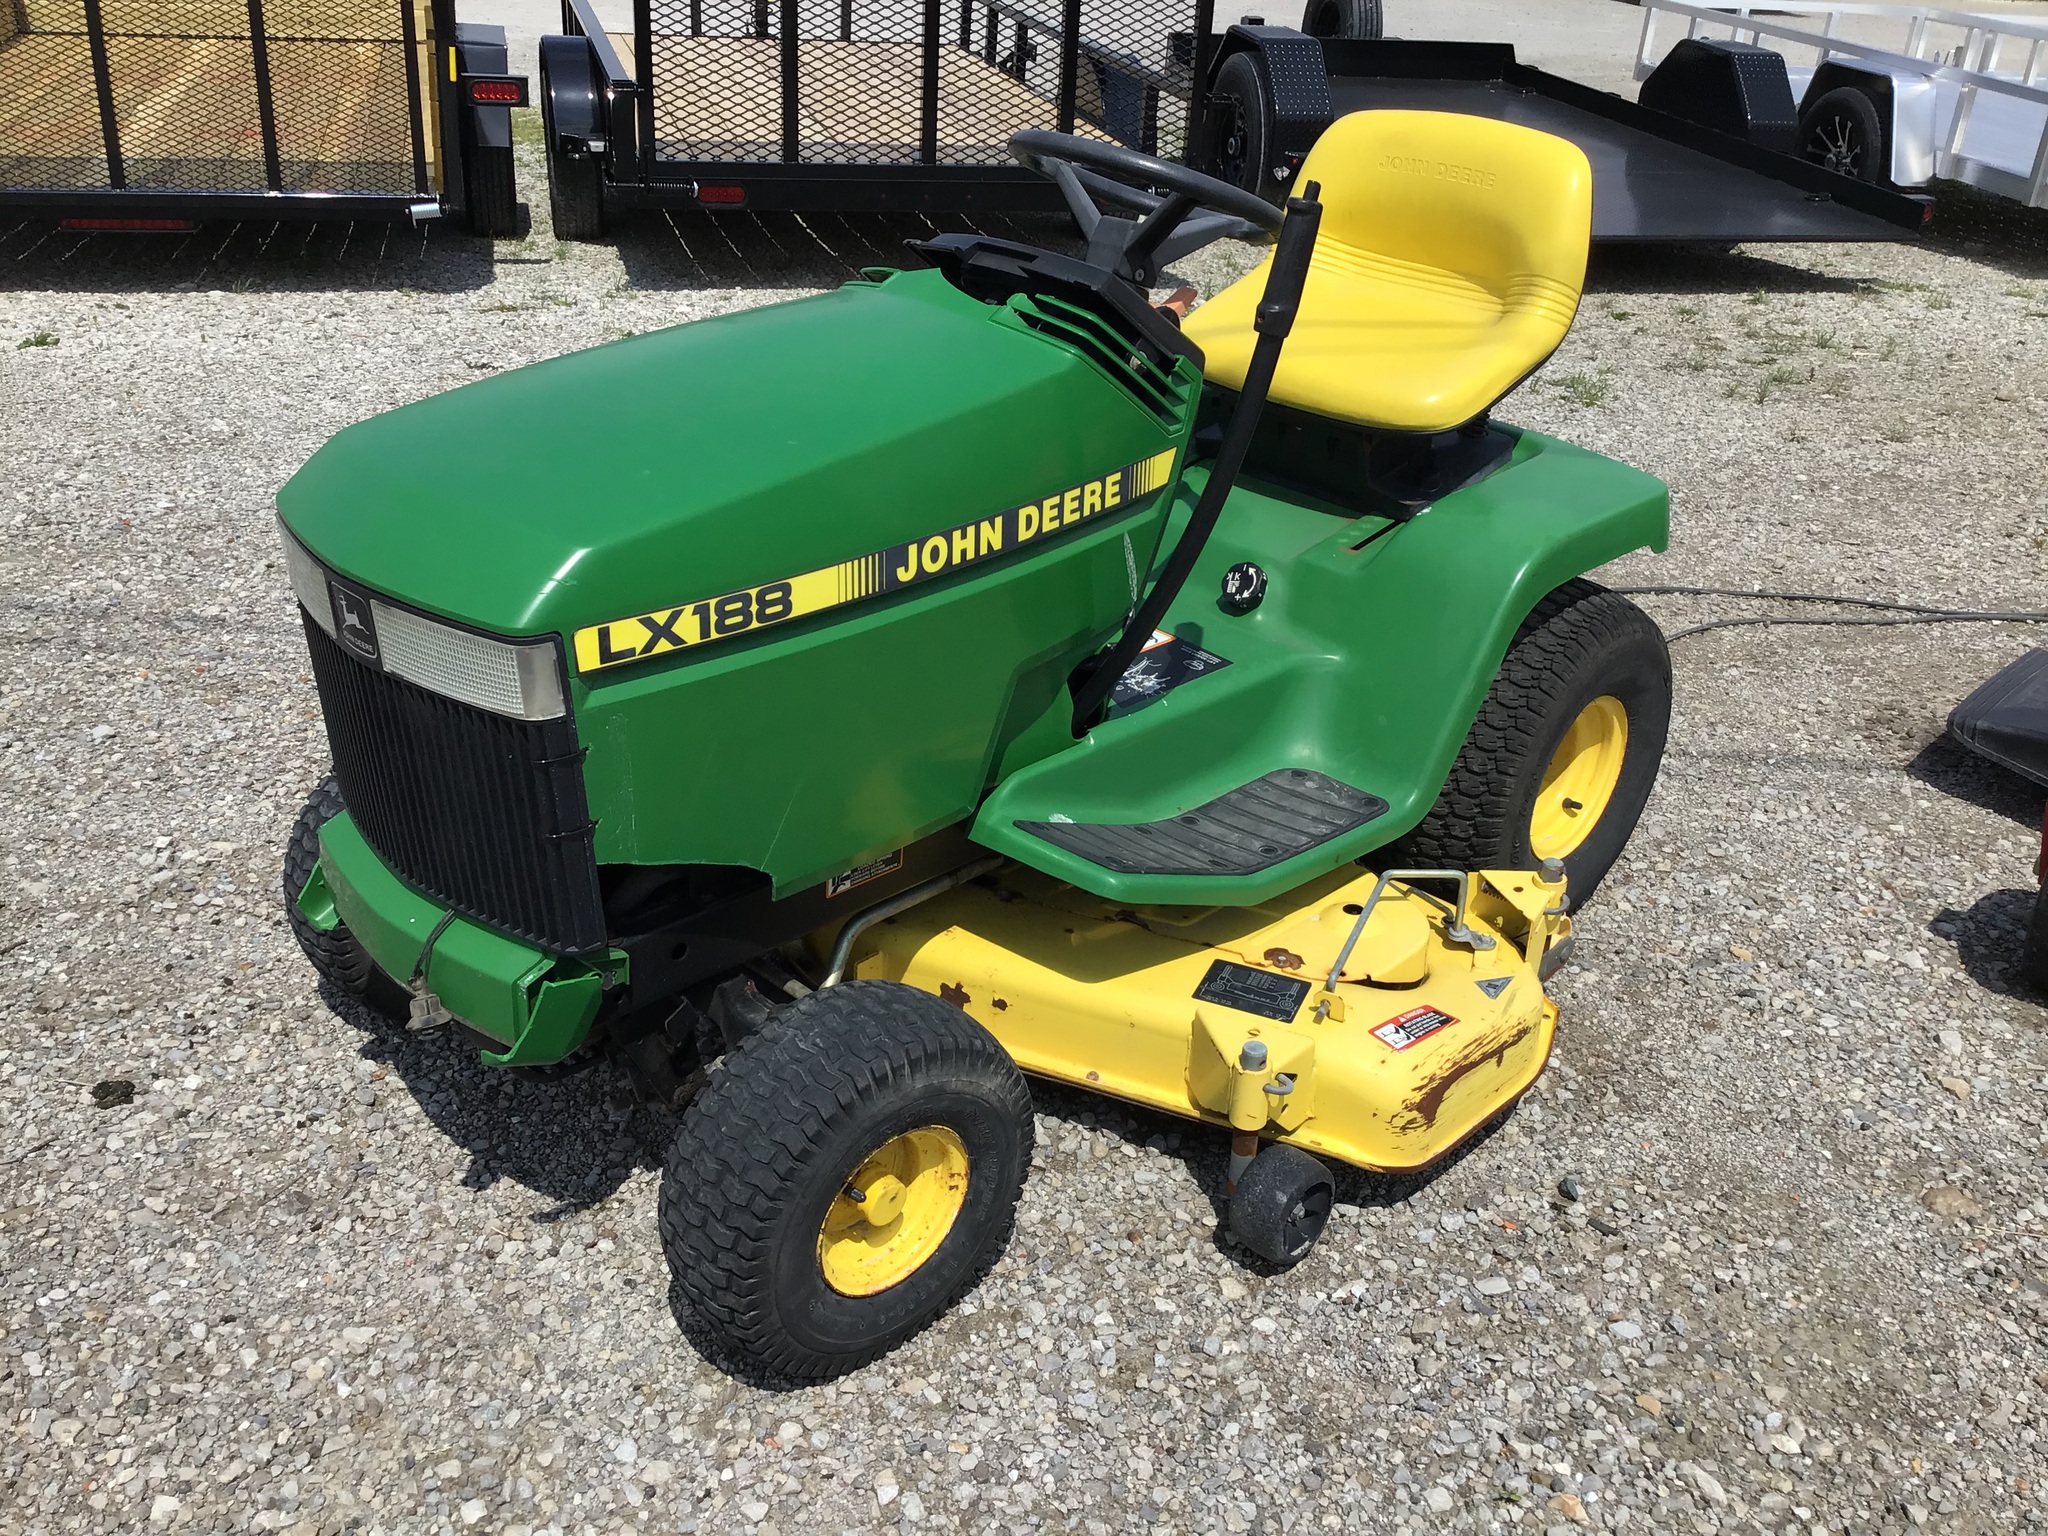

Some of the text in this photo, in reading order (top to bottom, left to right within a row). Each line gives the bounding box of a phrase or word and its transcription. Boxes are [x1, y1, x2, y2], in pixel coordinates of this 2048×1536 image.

[1378, 155, 1497, 190] JOHN DEERE
[596, 471, 1122, 667] LX188 JOHN DEERE
